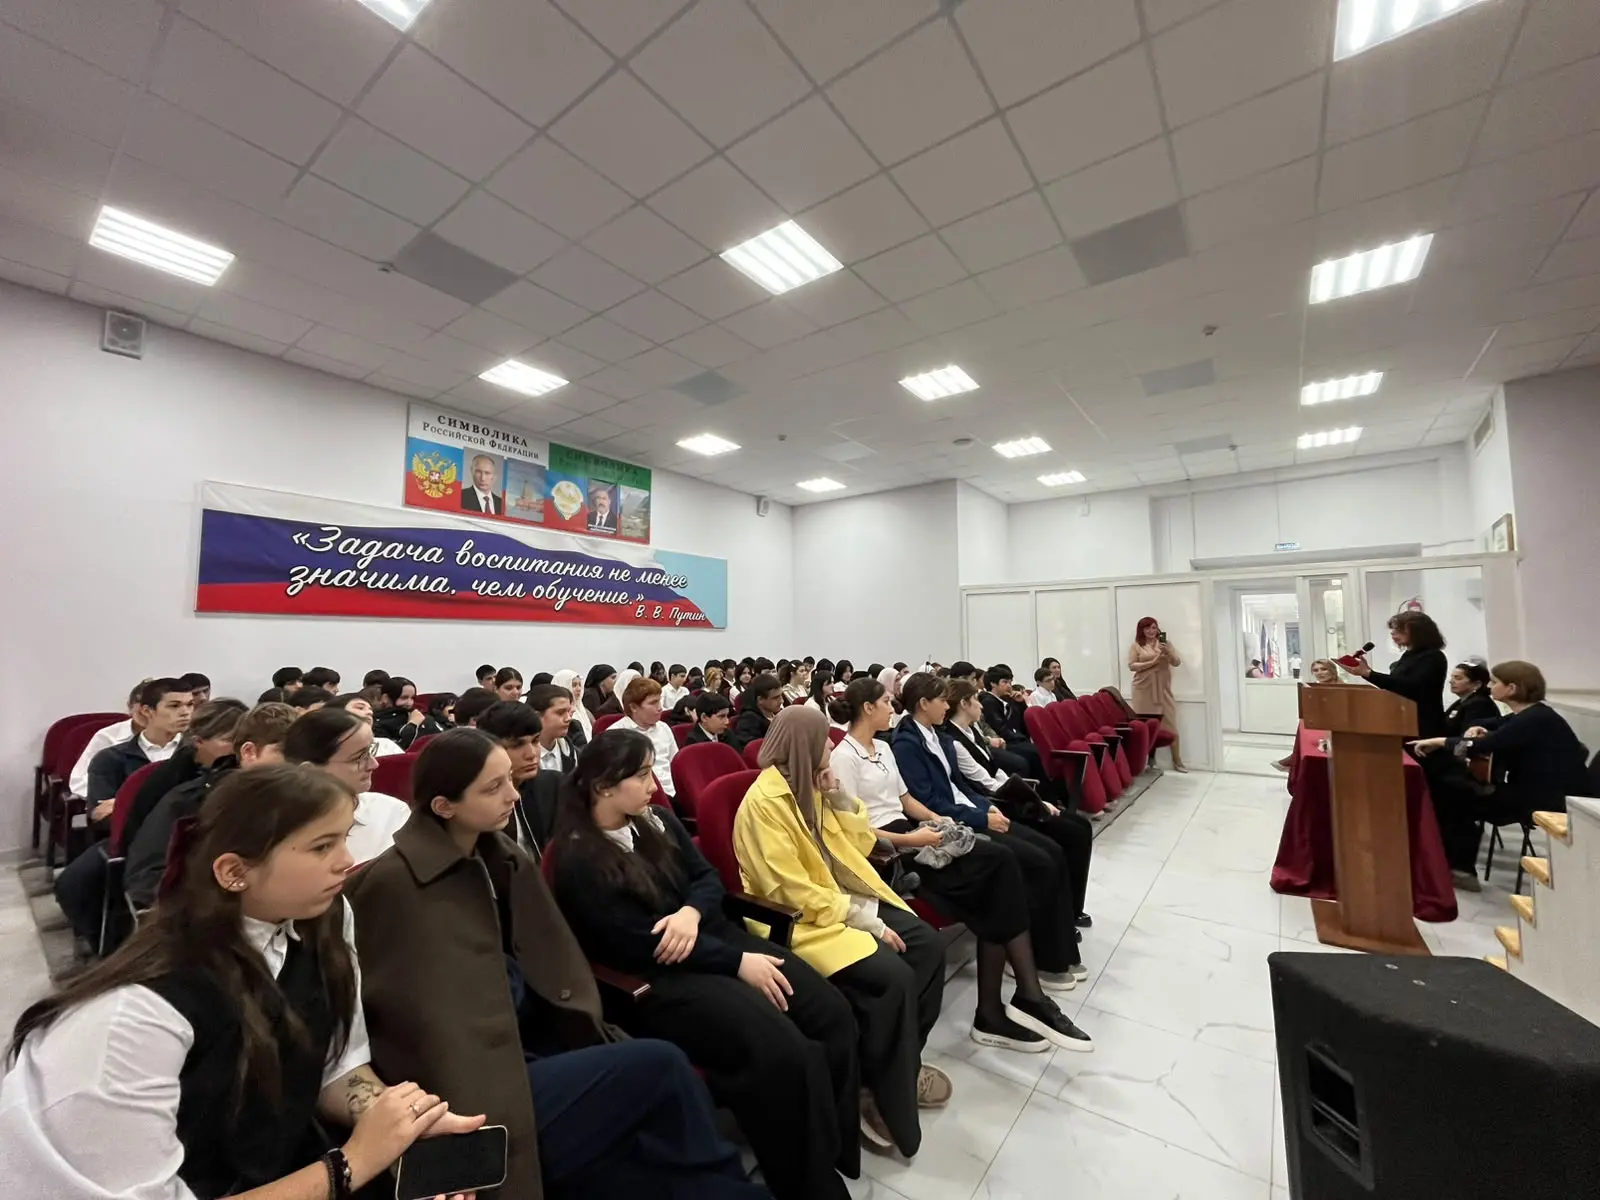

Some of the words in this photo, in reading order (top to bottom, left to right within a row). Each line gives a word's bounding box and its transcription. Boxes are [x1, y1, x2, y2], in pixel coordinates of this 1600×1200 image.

[437, 415, 528, 447] СИМВОЛИКА
[292, 526, 444, 569] «Задача
[455, 539, 604, 579] воспитания
[608, 567, 632, 583] не
[635, 570, 688, 588] менее
[471, 578, 526, 598] чем
[635, 604, 648, 618] В.
[652, 605, 664, 619] В.
[669, 606, 706, 626] Путин
